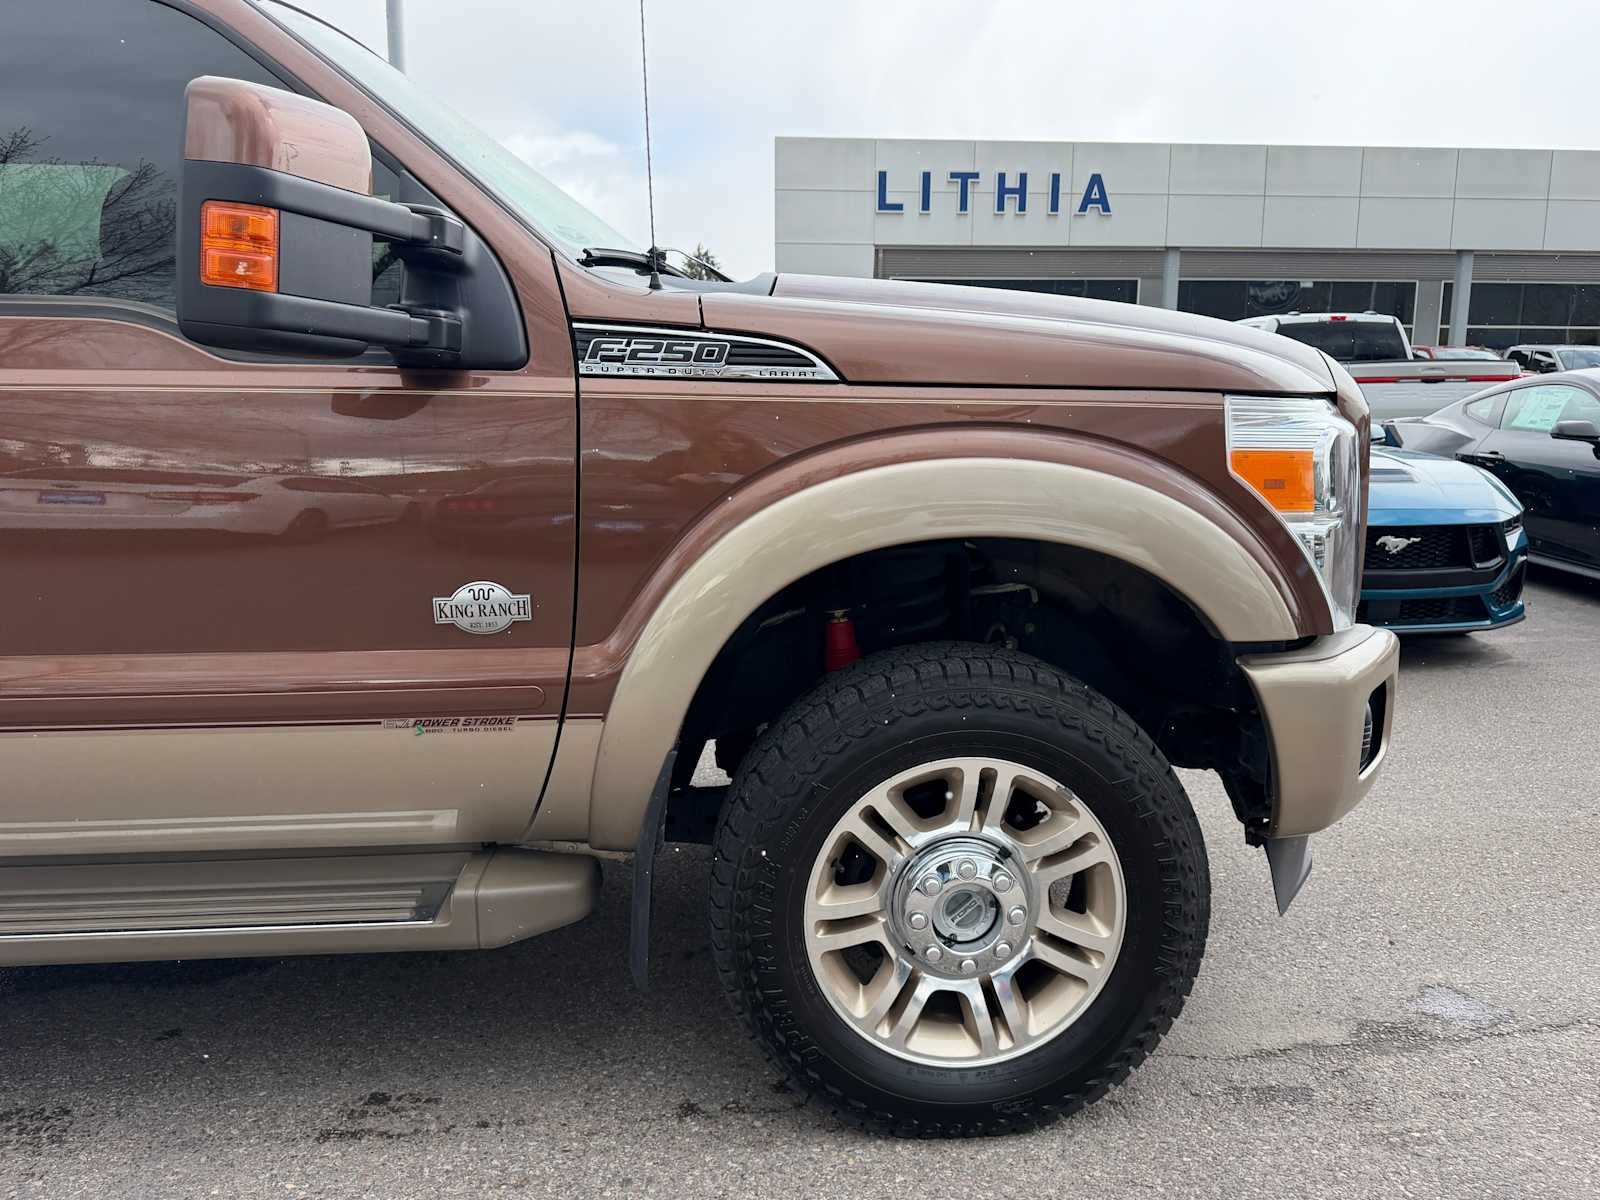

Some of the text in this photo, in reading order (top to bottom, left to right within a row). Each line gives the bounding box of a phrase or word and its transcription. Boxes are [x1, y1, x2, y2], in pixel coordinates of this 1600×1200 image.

[877, 170, 1112, 214] LITHIA
[584, 338, 731, 367] F-250
[585, 365, 656, 374] SUPER
[438, 601, 528, 619] KING RANCH
[413, 719, 460, 727] POWER
[461, 717, 516, 727] STROKE
[950, 899, 978, 924] FORD
